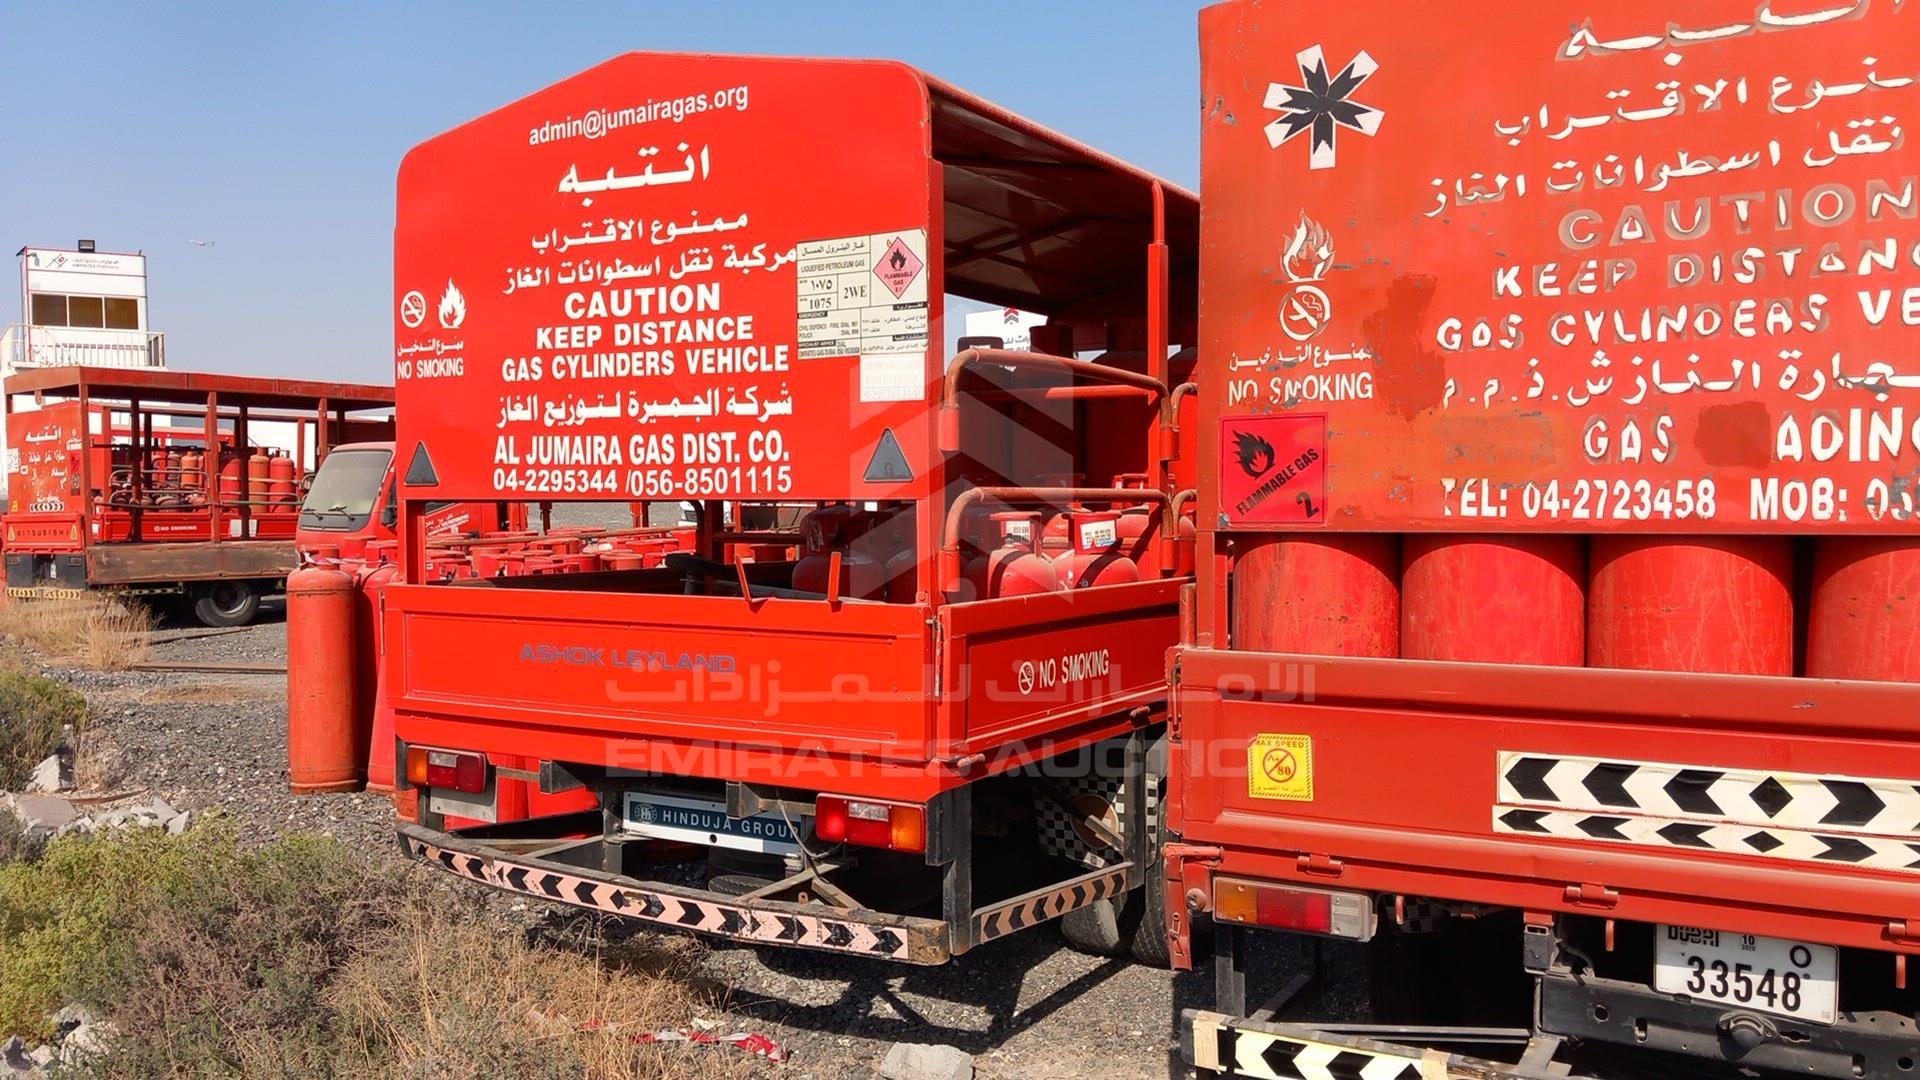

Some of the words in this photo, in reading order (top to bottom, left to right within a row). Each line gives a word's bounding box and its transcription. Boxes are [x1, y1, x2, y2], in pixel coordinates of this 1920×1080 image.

[529, 84, 748, 145] admin@jumairagas.org
[1495, 76, 1747, 146] الاقتراب
[1803, 115, 1905, 167] نقل
[558, 142, 710, 207] انتبه
[1423, 172, 1526, 217] الغاز
[650, 209, 748, 242] ممنوع
[1559, 176, 1918, 249] CAUTION
[531, 217, 643, 251] الاقتراب
[502, 264, 550, 294] الغاز
[560, 257, 662, 289] اسطوانات
[669, 248, 714, 281] نقل
[825, 261, 854, 271] PETROLEUM
[855, 260, 865, 268] GAS
[1493, 253, 1636, 299] KEEP
[564, 282, 720, 319] CAUTION
[809, 298, 832, 309] 1075
[844, 286, 867, 299] 2WE
[536, 325, 602, 349] KEEP
[613, 316, 753, 346] DISTANCE
[1436, 313, 1525, 351] GAS
[397, 360, 413, 380] NO
[416, 357, 464, 379] SMOKING
[502, 357, 543, 381] GAS
[552, 350, 675, 379] CYLINDERS
[685, 345, 789, 374] VEHICLE
[1621, 352, 1761, 405] الغاز
[627, 387, 720, 424] الجميرة
[725, 381, 792, 423] شركة
[1228, 379, 1259, 406] NO
[1270, 371, 1373, 405] SMOKING
[496, 393, 538, 428] الغاز
[543, 390, 622, 427] لتوزيع
[493, 435, 520, 465] AL
[526, 435, 623, 465] JUMAIRA
[629, 433, 675, 465] GAS
[683, 431, 741, 464] DIST.
[748, 430, 790, 462] CO.
[1583, 414, 1674, 464] GAS
[493, 468, 618, 492] 04-2295344
[1235, 463, 1301, 517] FLAMMABLE
[1294, 447, 1320, 472] GAS
[1296, 491, 1320, 519] 2
[1440, 478, 1509, 518] TEL:
[1522, 477, 1717, 521] 04-2723458
[1750, 477, 1848, 522] MOB:
[17, 528, 69, 537] MITSUBISHI
[520, 644, 605, 666] ASHOK
[611, 650, 736, 673] LEYLAND
[1039, 661, 1057, 689] NO
[1062, 649, 1110, 684] SMOKING
[1275, 740, 1305, 748] SPEED
[1277, 765, 1291, 776] 80
[662, 810, 733, 831] HINDUJA
[741, 820, 799, 839] GROUP
[1742, 935, 1755, 945] 10
[1687, 956, 1801, 1012] 33548
